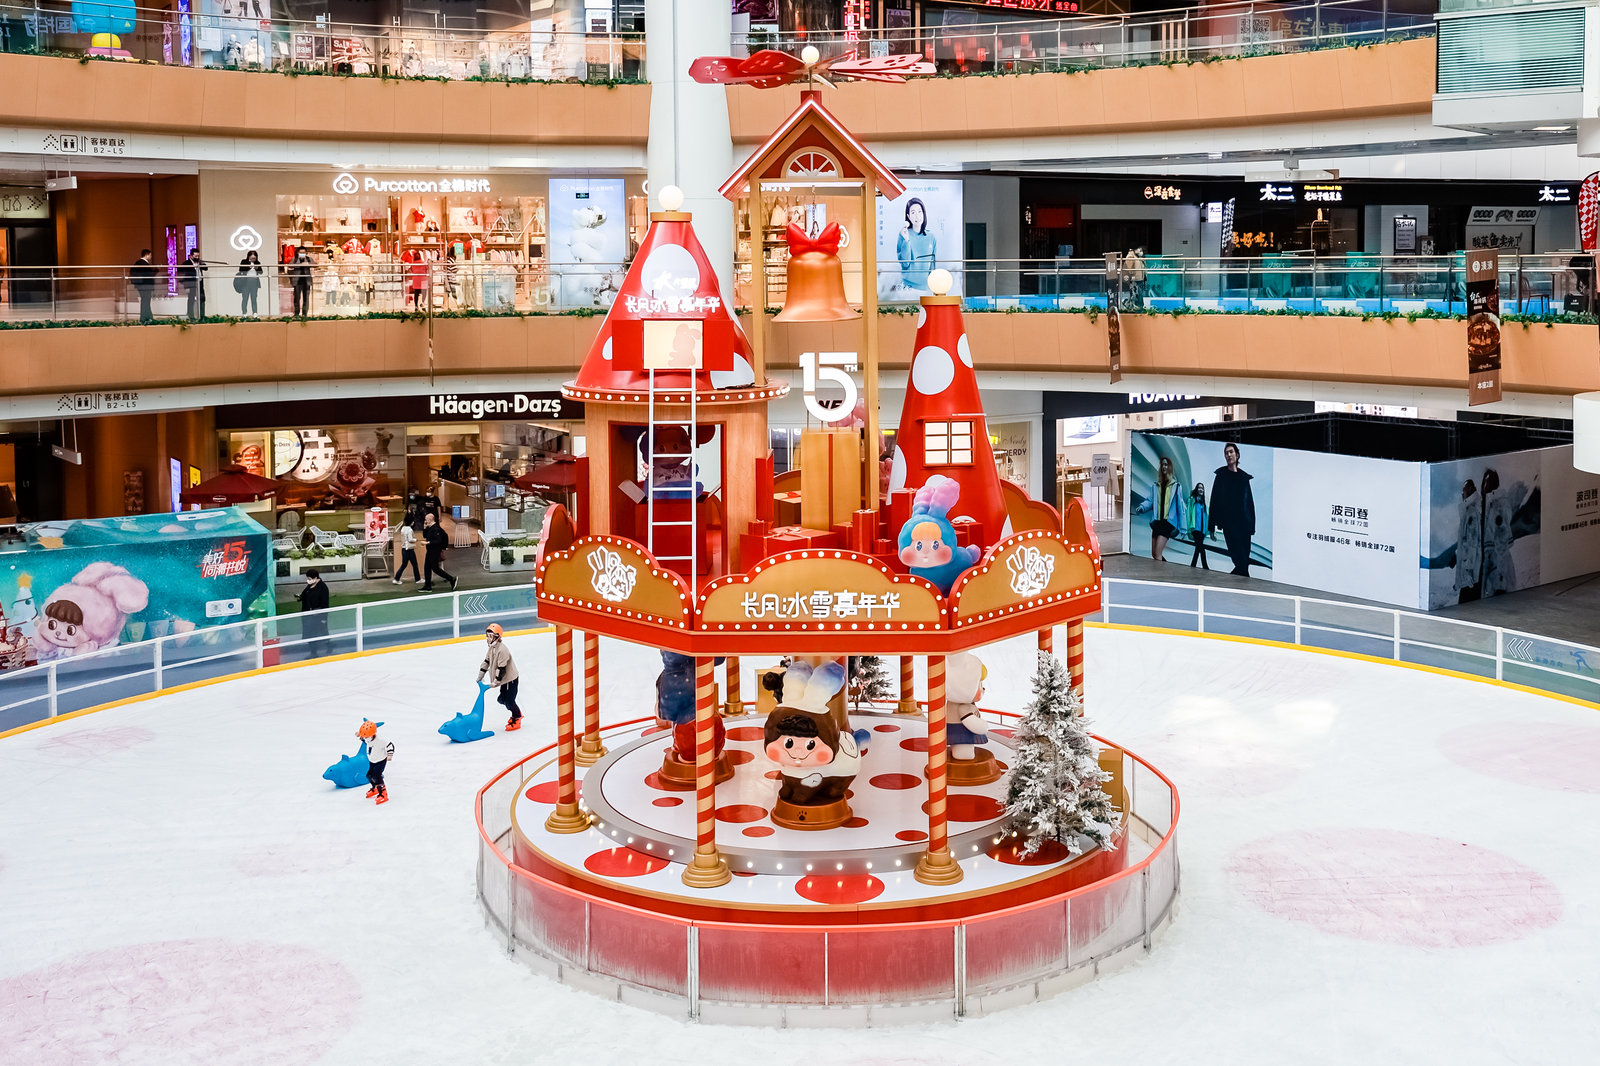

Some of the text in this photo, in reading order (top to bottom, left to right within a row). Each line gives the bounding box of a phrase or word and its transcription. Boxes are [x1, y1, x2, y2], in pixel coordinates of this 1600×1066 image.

[91, 137, 126, 147] 客梯直达
[364, 177, 438, 192] Purcotton
[1259, 184, 1295, 201] 太二
[1538, 185, 1571, 202] 太二
[844, 364, 858, 373] TH
[799, 352, 858, 423] 15
[104, 392, 139, 402] 客梯直达
[106, 401, 137, 409] B2-L5
[1331, 504, 1369, 520] 波司登
[740, 589, 900, 619] 长风冰雪嘉年华
